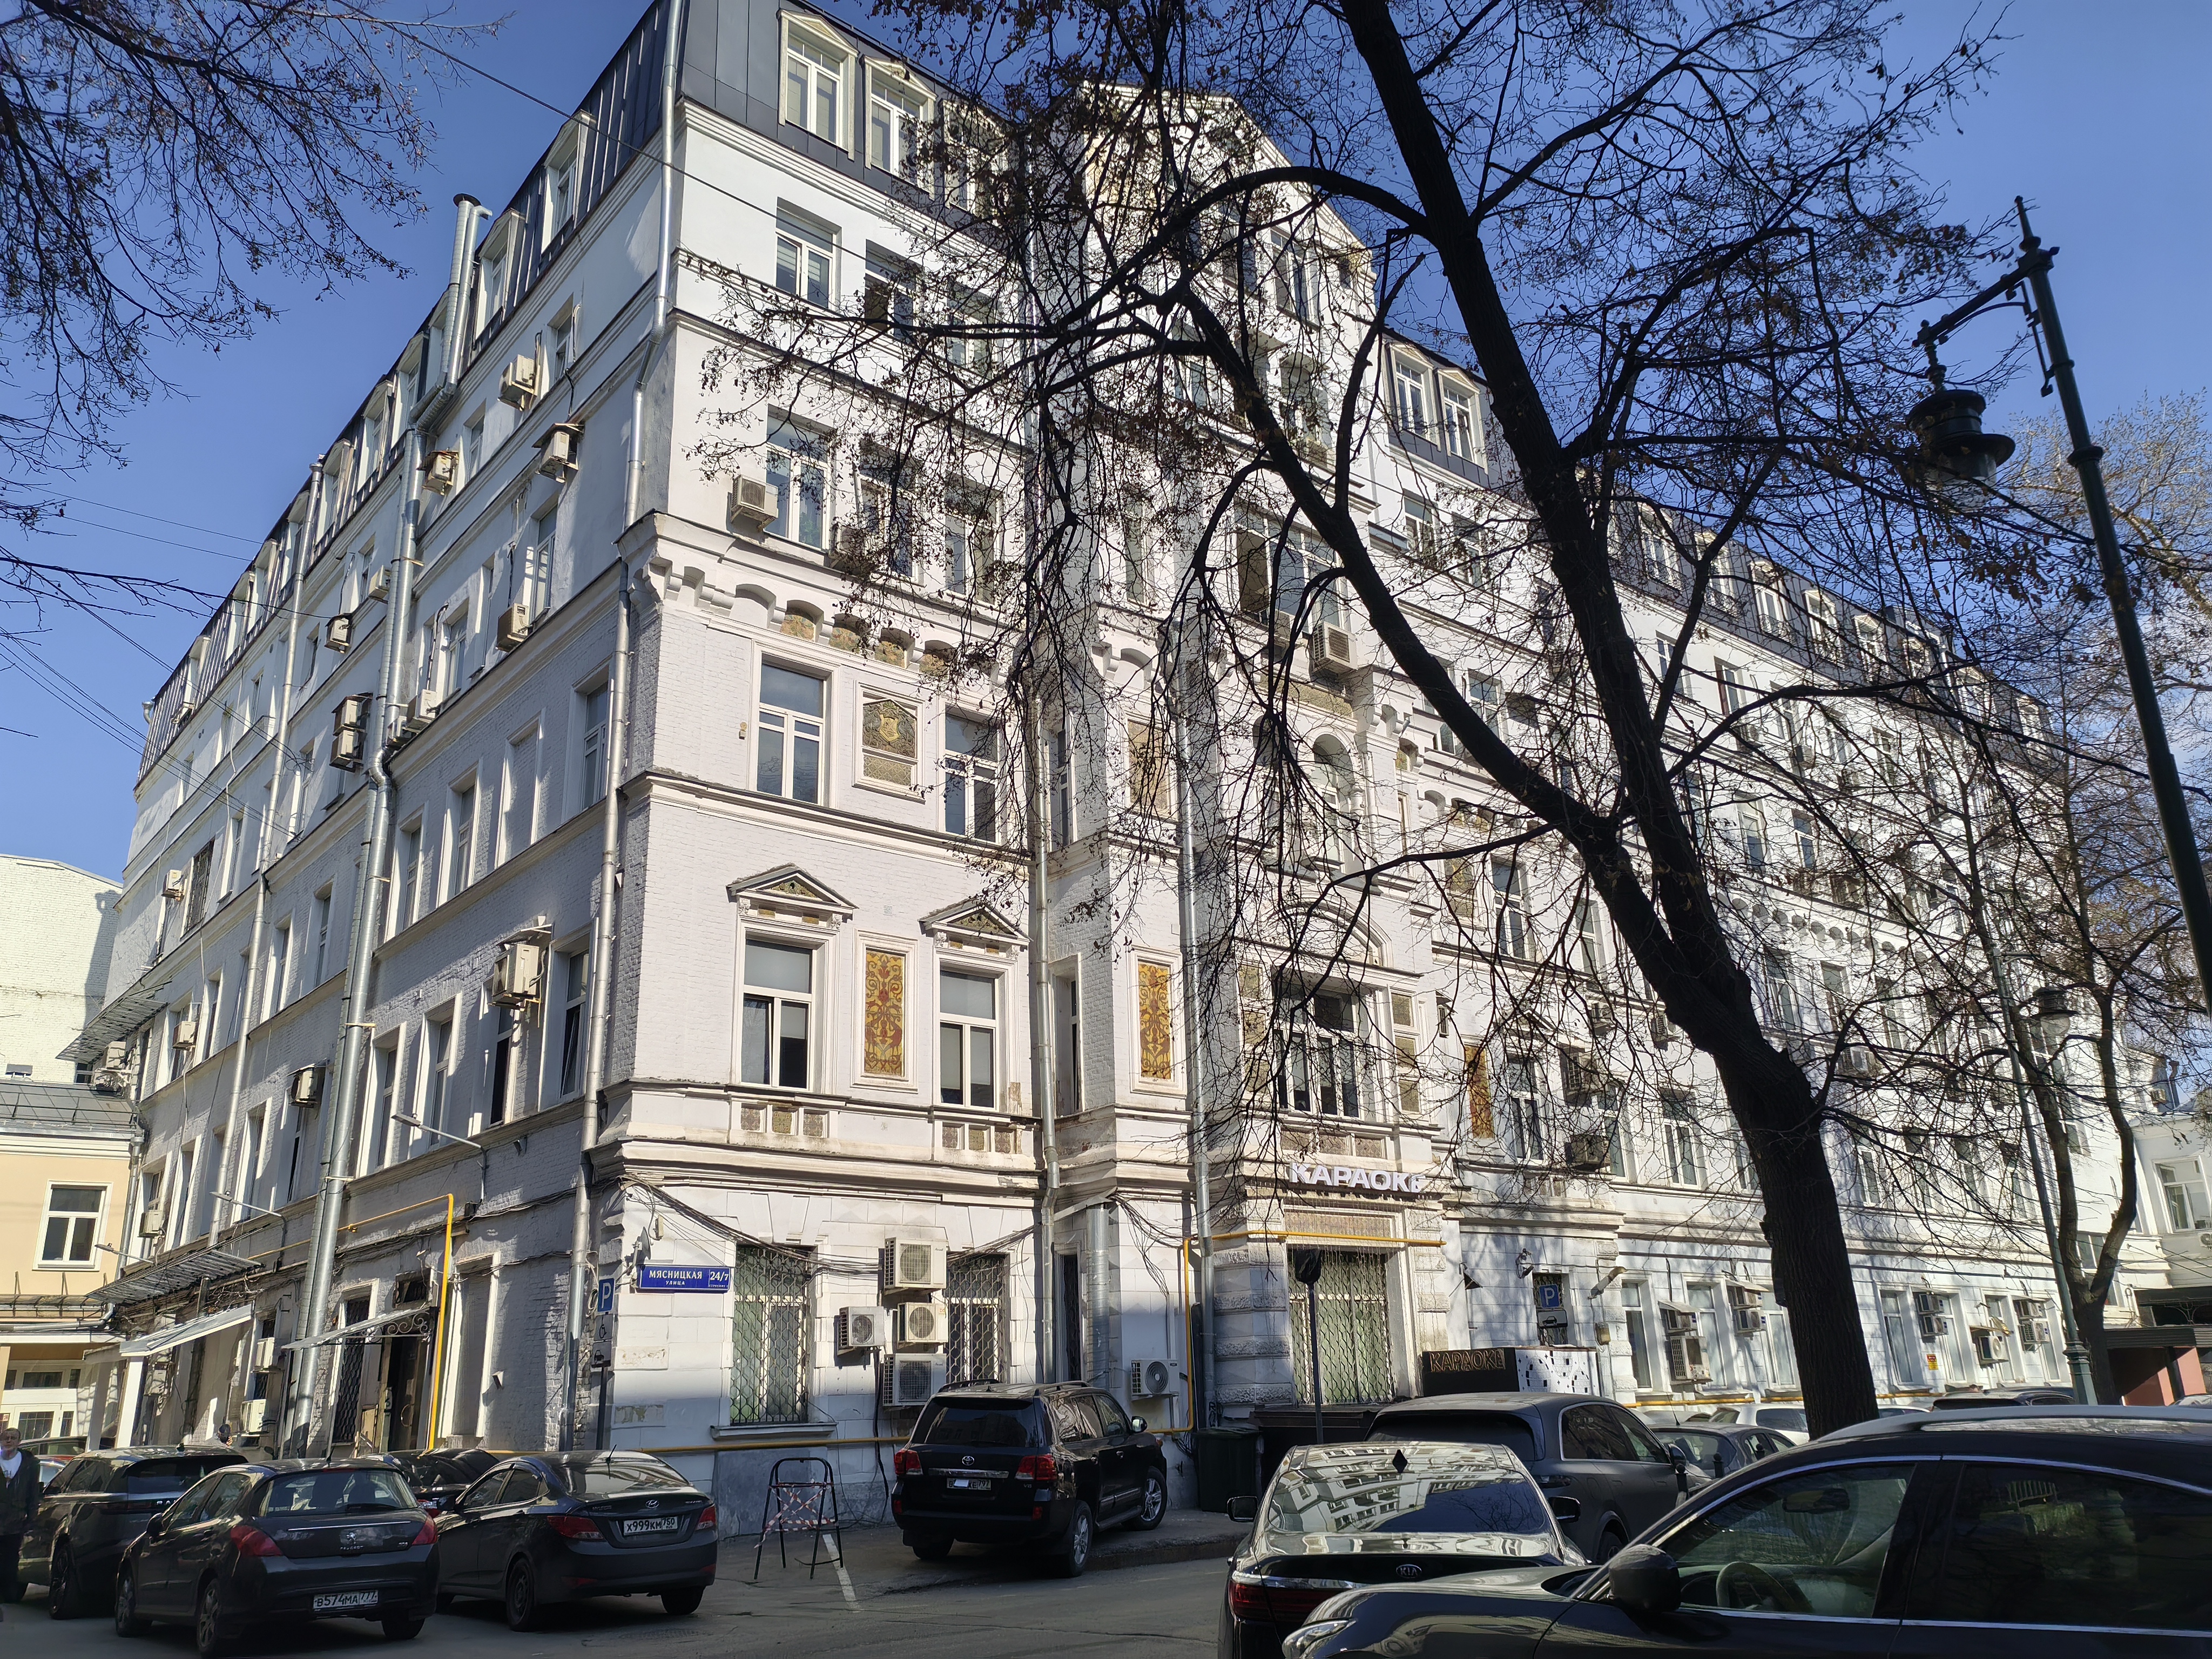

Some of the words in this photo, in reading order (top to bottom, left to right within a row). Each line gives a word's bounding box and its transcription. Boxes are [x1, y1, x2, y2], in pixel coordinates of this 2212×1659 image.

[1290, 1162, 1426, 1193] КАРАОКЕ
[649, 1270, 702, 1280] МЯСНИЦКАЯ
[710, 1271, 729, 1282] 24/7
[1429, 1348, 1506, 1372] КАРАОКЕ
[627, 1520, 662, 1532] Х999КМ
[1400, 1567, 1418, 1576] KIA
[317, 1594, 358, 1607] В574МА
